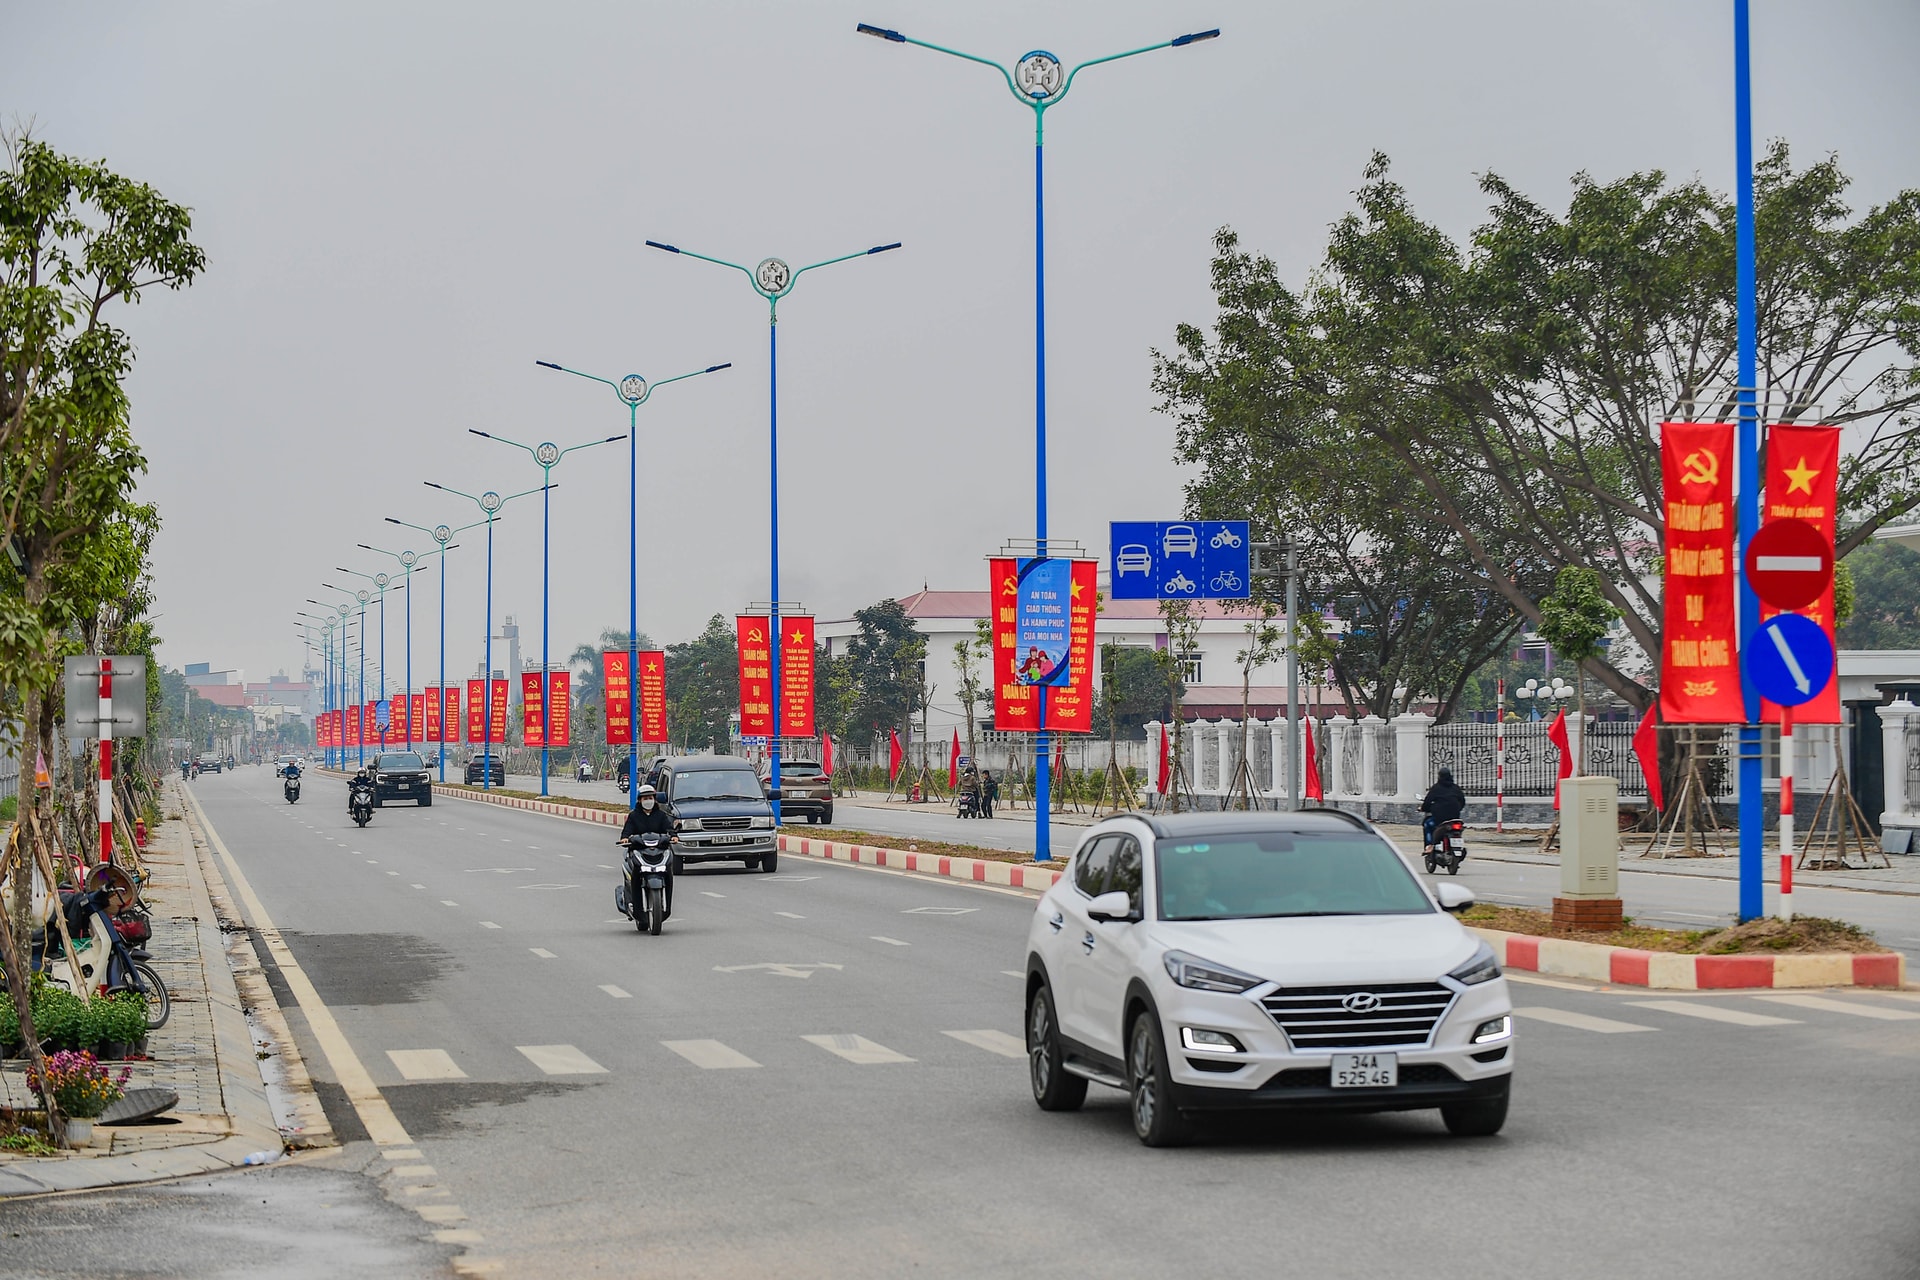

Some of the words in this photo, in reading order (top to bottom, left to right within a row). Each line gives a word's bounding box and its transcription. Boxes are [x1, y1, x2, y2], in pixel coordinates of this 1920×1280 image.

[1030, 591, 1040, 600] AN
[1026, 604, 1040, 613] GIAO
[1351, 1055, 1378, 1069] 34A
[1338, 1071, 1389, 1085] 525.46
